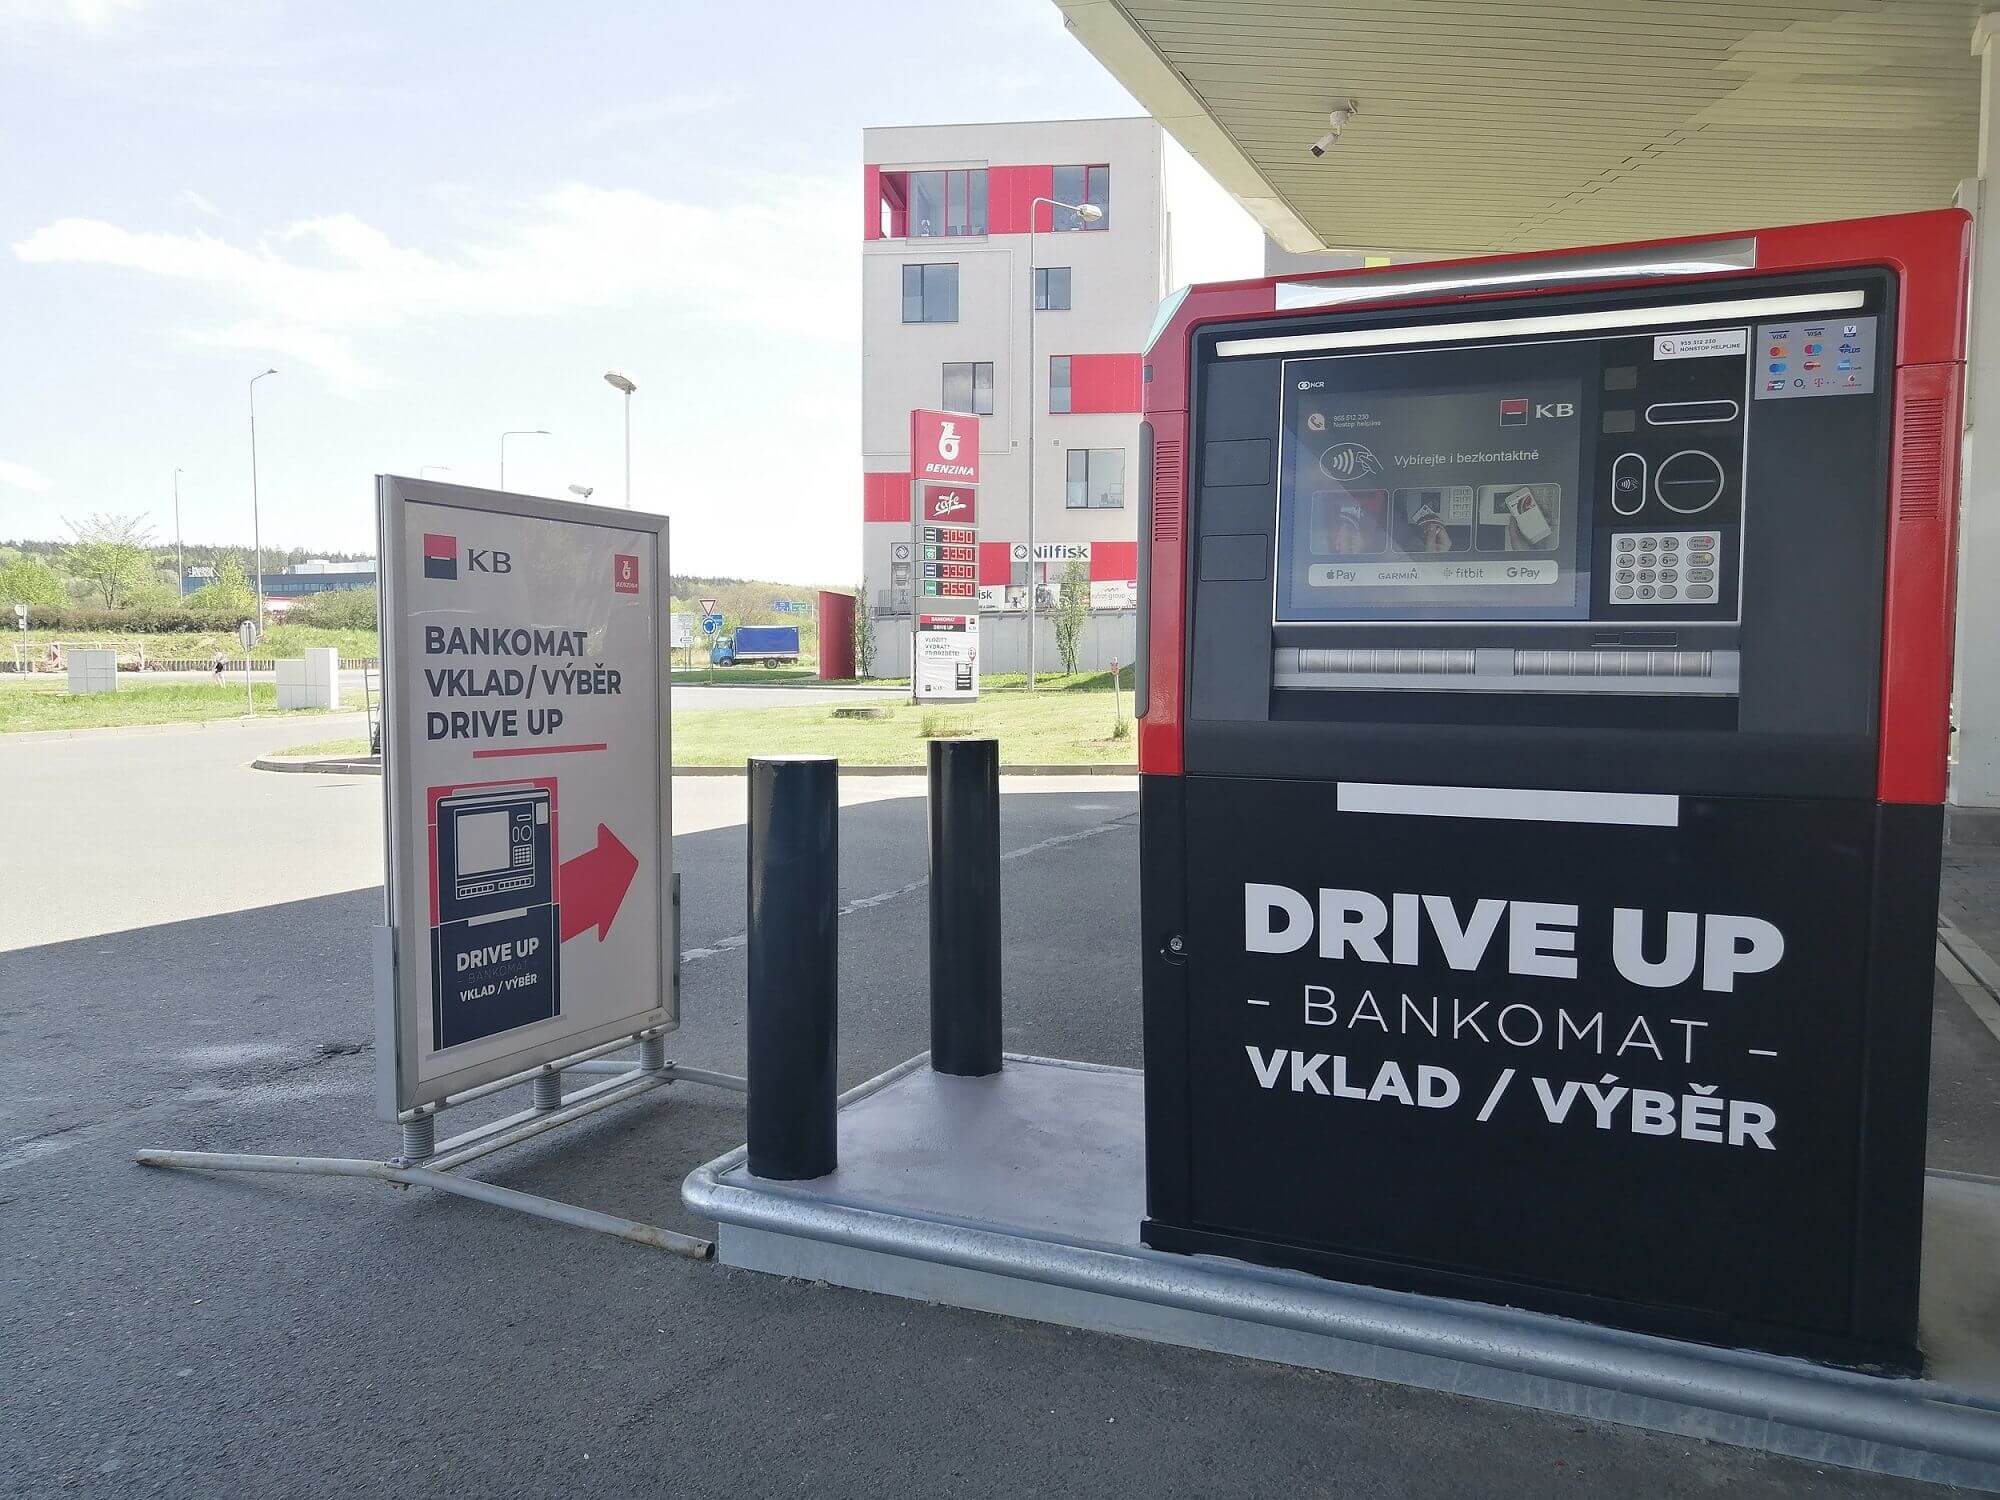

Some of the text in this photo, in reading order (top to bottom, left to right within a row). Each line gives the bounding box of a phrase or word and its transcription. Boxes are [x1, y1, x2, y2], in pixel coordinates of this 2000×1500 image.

[1310, 381, 1325, 389] NCR
[1535, 403, 1574, 419] KB
[1394, 453, 1446, 468] Vybírejte
[1457, 449, 1539, 463] bezkontaktně
[925, 463, 974, 476] BENZINA
[467, 548, 512, 574] KB
[1336, 570, 1357, 583] Pay
[1378, 570, 1418, 580] GARMIN
[1456, 567, 1484, 579] fitbit
[1520, 567, 1541, 579] Pay
[425, 625, 588, 657] BANKOMAT
[427, 708, 563, 740] DRIVE UP
[1245, 882, 1785, 992] DRIVE UP
[456, 937, 540, 972] DRIVE UP
[460, 984, 496, 1002] VKLAD
[1304, 985, 1709, 1064] BANKOMAT
[1245, 1045, 1777, 1151] VKLAD / VÝBĚR
